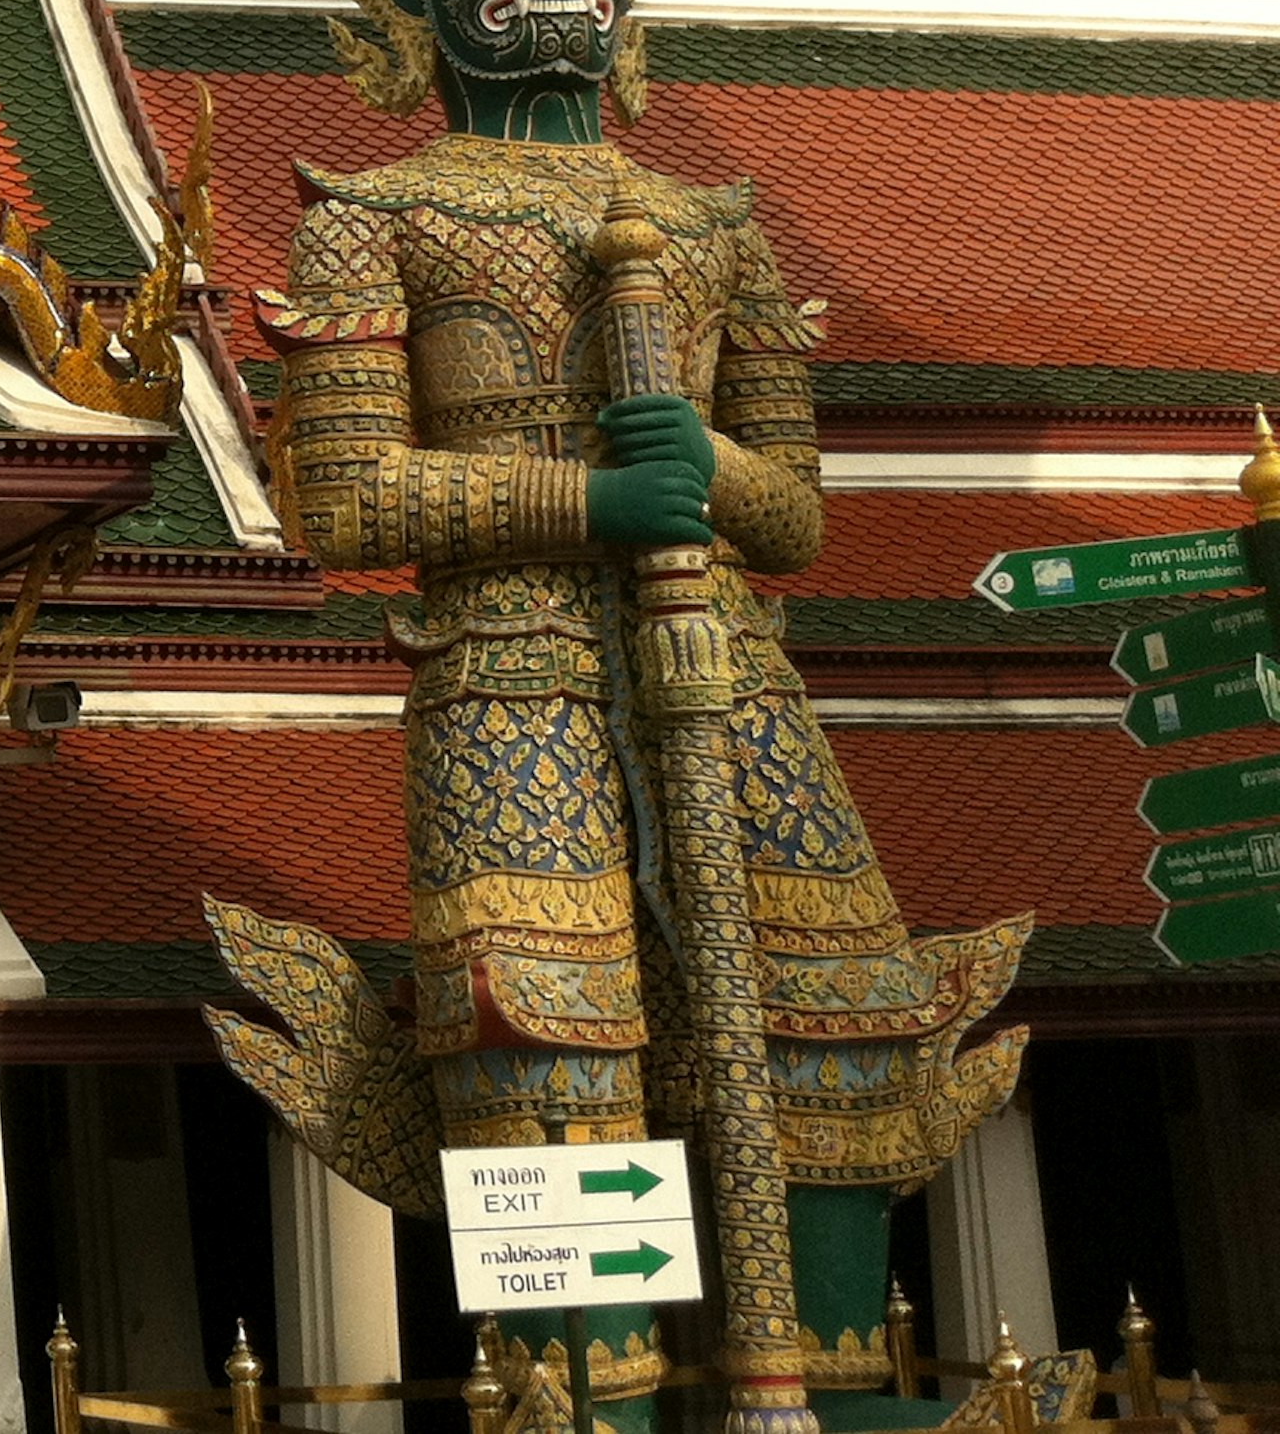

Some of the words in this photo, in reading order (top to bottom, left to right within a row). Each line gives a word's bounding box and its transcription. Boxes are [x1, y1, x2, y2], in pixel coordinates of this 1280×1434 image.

[997, 576, 1008, 590] 3
[1098, 573, 1157, 591] Cloisters
[1161, 570, 1172, 585] &
[1175, 565, 1244, 582] Ramakien
[472, 1167, 546, 1186] ทางออก
[484, 1193, 543, 1213] EXIT
[481, 1243, 579, 1265] ทางไปห้องสุขา
[497, 1272, 568, 1293] TOILET
